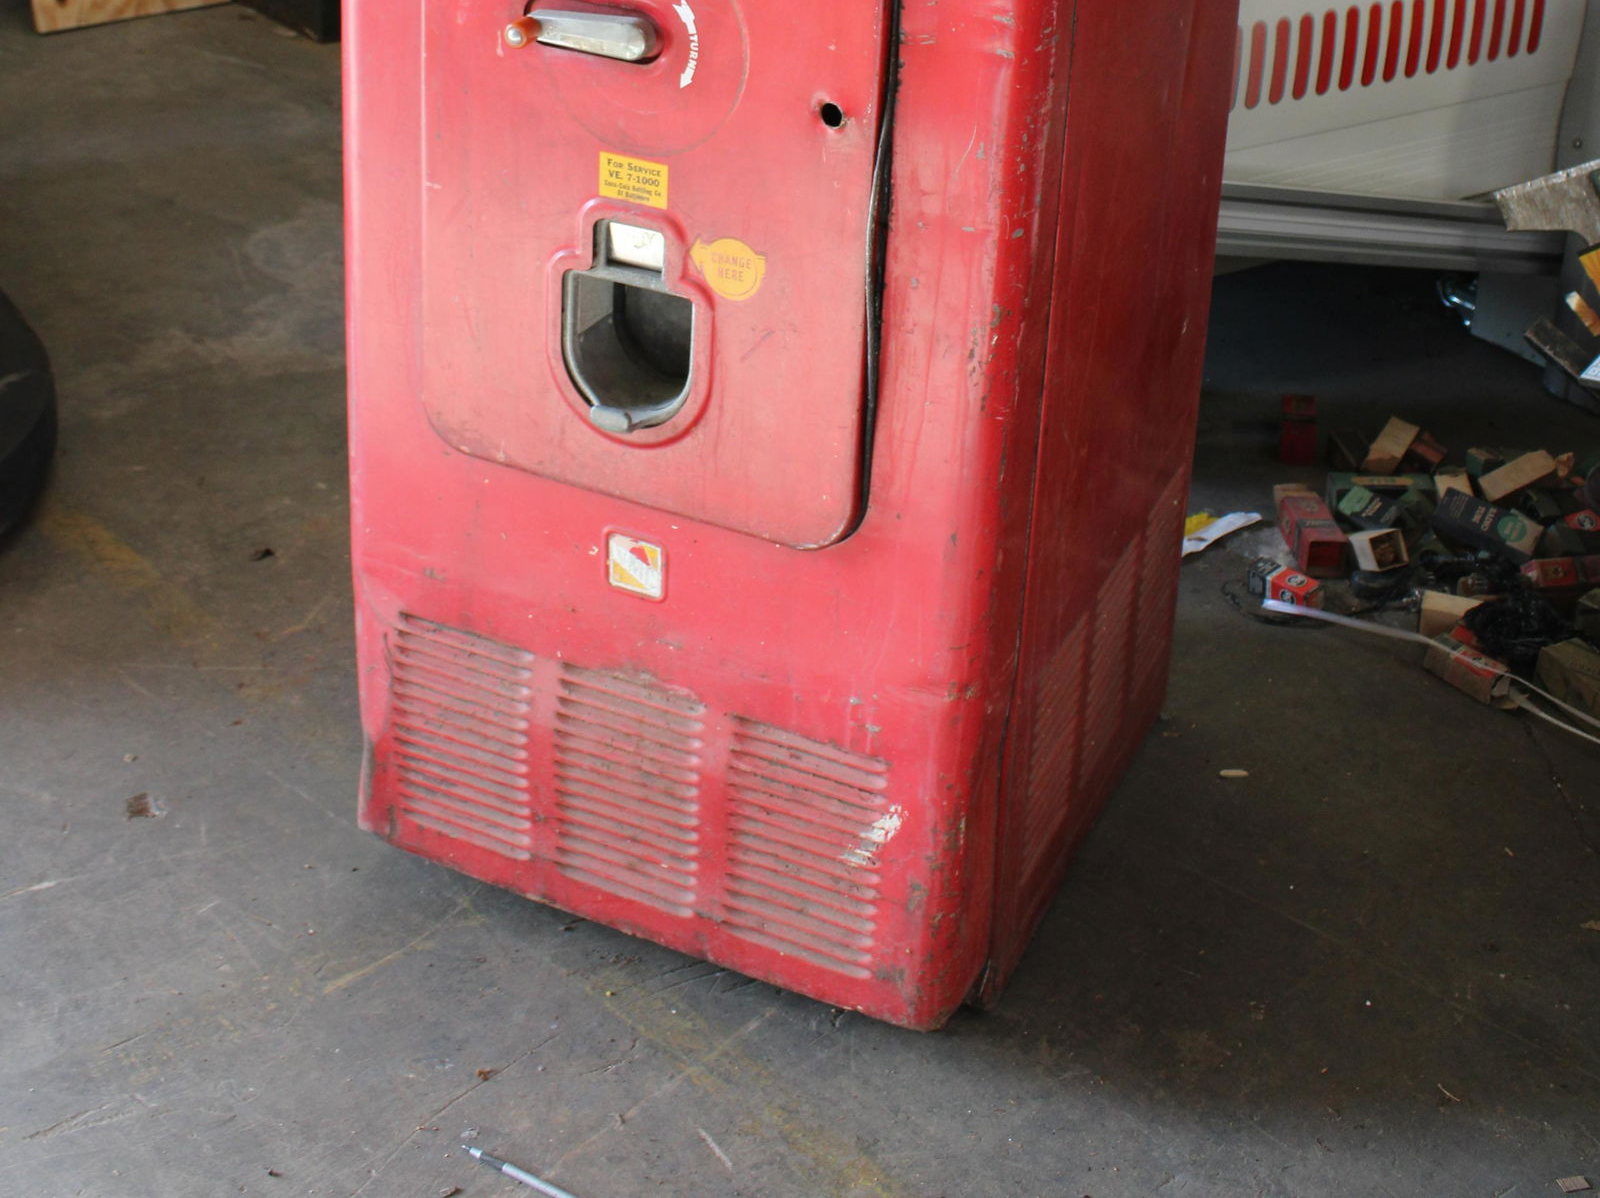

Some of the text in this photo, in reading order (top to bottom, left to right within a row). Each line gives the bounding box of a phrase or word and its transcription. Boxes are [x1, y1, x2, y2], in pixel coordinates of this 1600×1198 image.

[688, 34, 699, 70] TURN
[627, 173, 660, 188] 7-1000
[711, 252, 752, 271] CHANGE
[718, 268, 744, 282] HERE
